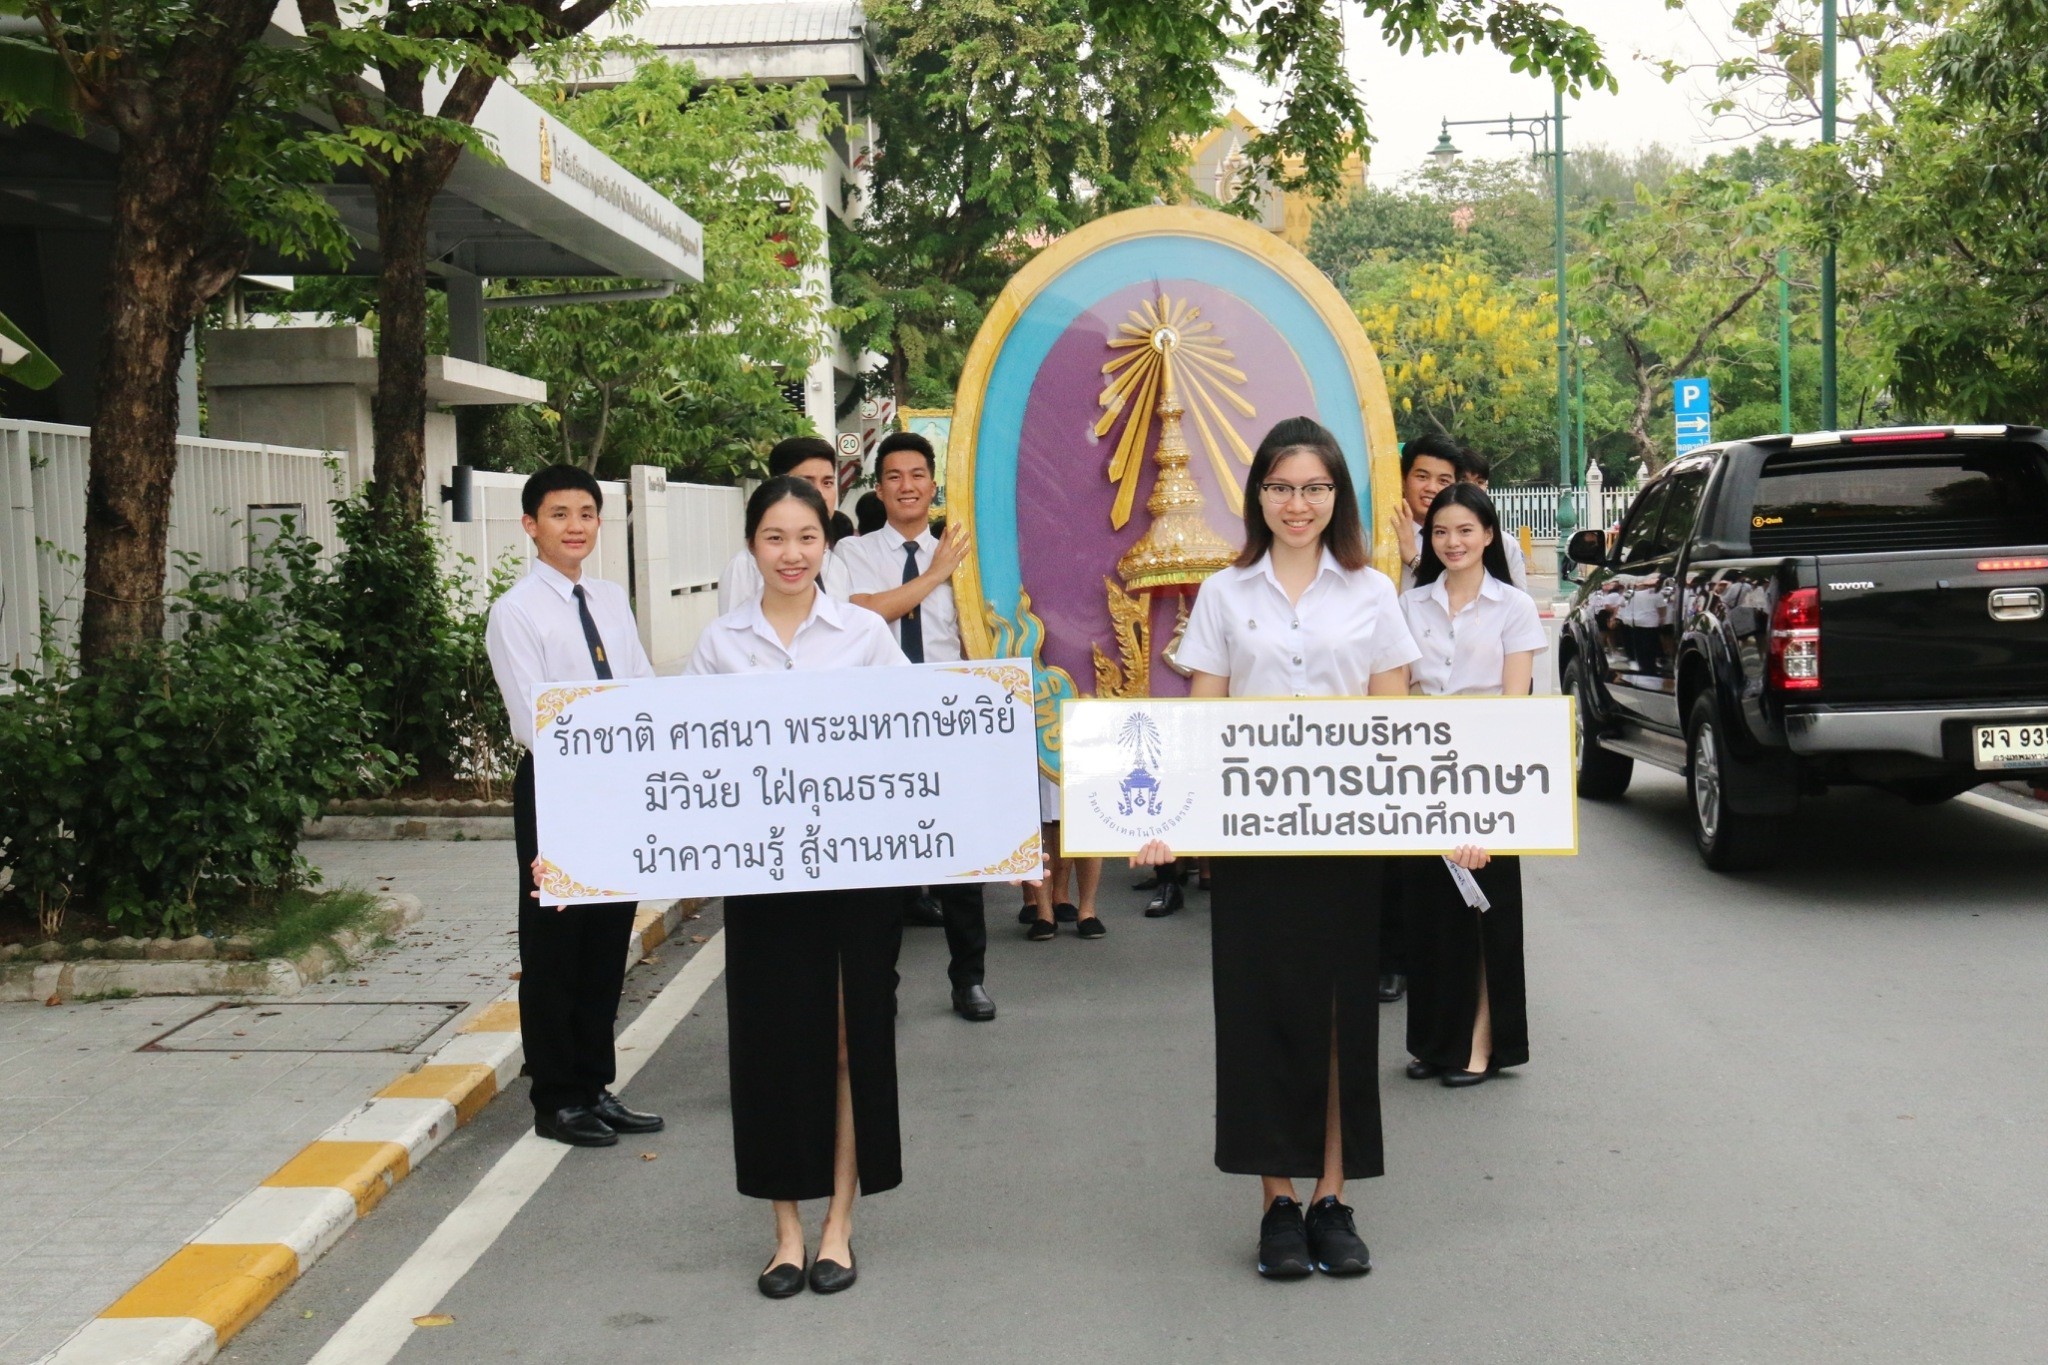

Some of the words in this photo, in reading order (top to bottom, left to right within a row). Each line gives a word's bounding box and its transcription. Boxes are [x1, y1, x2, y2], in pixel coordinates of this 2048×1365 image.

[1683, 385, 1700, 408] P
[843, 438, 856, 449] 20
[1828, 582, 1875, 590] TOYOTA
[553, 712, 655, 756] รักชาติ
[670, 719, 771, 750] ศาสนา
[784, 690, 1015, 744] พระมหากษัตริย์
[1221, 713, 1451, 747] งานฝ่ายบริหาร
[2020, 728, 2048, 747] 93
[1221, 749, 1550, 797] กิจการนักศึกษา
[645, 768, 740, 812] มีวินัย
[752, 765, 940, 817] ใฝ่คุณธรรม
[1221, 801, 1515, 836] และสโมสรนักศึกษา
[633, 826, 785, 881] นำความรู้
[799, 819, 955, 879] สู้งานหนัก
